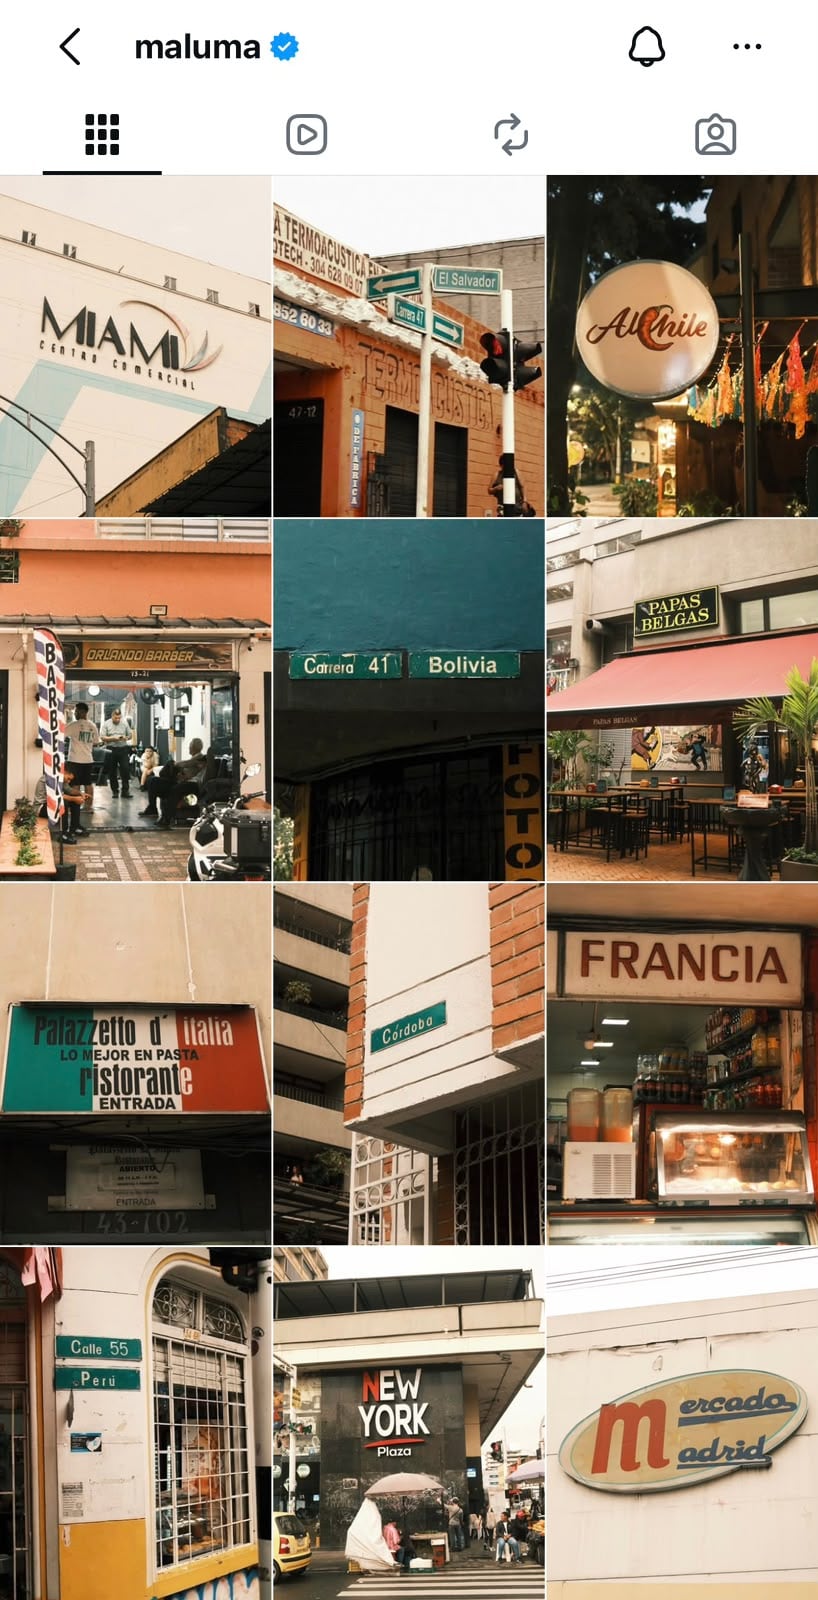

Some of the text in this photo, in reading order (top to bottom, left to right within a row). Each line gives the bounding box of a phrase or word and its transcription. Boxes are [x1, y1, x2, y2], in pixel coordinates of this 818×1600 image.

[134, 33, 261, 59] maluma
[284, 214, 366, 278] TERMOACUSTICA
[311, 257, 325, 274] 304
[328, 265, 342, 283] 628
[438, 273, 496, 288] El Salvador
[273, 302, 332, 336] 852 60 33
[396, 301, 415, 322] Carrera
[416, 310, 424, 326] 47
[41, 295, 179, 370] MIAMI
[39, 340, 195, 390] CENTRO COMERCIAL
[351, 446, 360, 505] FABRICA
[648, 594, 701, 616] PAPAS
[640, 608, 709, 632] BELGAS
[86, 647, 194, 662] ORLANDO BARBER
[304, 657, 389, 674] Carrera 41
[429, 656, 497, 674] Bolivia
[580, 939, 788, 984] FRANCIA
[34, 1015, 136, 1046] Palazzetto
[184, 1016, 234, 1046] italia
[382, 1016, 433, 1044] Córdoba
[60, 1049, 200, 1061] LO MEJOR EN PASTA
[80, 1064, 193, 1096] ristorante
[100, 1097, 176, 1110] ENTRADA
[116, 1198, 156, 1206] ENTRADA
[71, 1340, 129, 1356] Calle 55
[81, 1371, 116, 1388] Perú
[362, 1368, 422, 1403] NEW
[358, 1403, 430, 1437] YORK
[377, 1447, 412, 1458] Plaza
